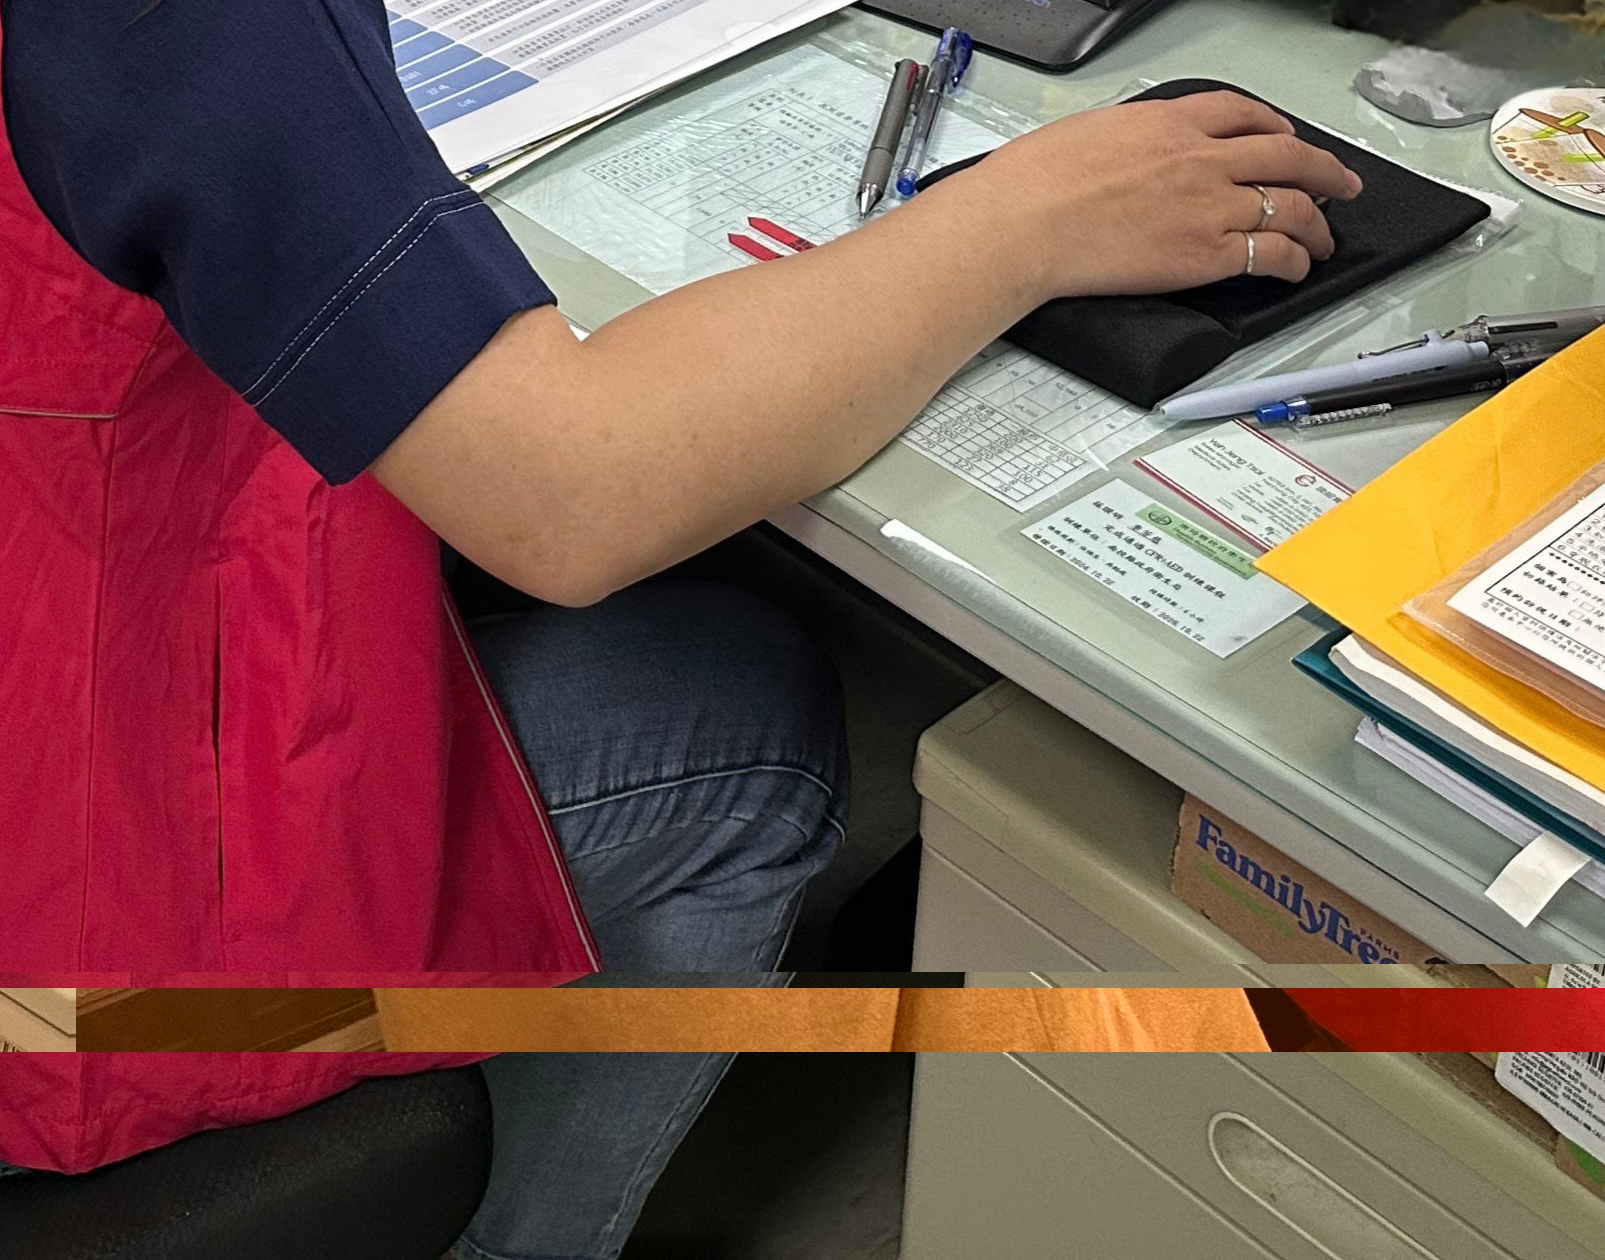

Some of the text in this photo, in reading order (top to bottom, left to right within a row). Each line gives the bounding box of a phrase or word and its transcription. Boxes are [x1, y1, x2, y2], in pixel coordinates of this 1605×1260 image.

[1022, 464, 1044, 478] 115
[1179, 522, 1254, 566] 南投縣政府衛生
